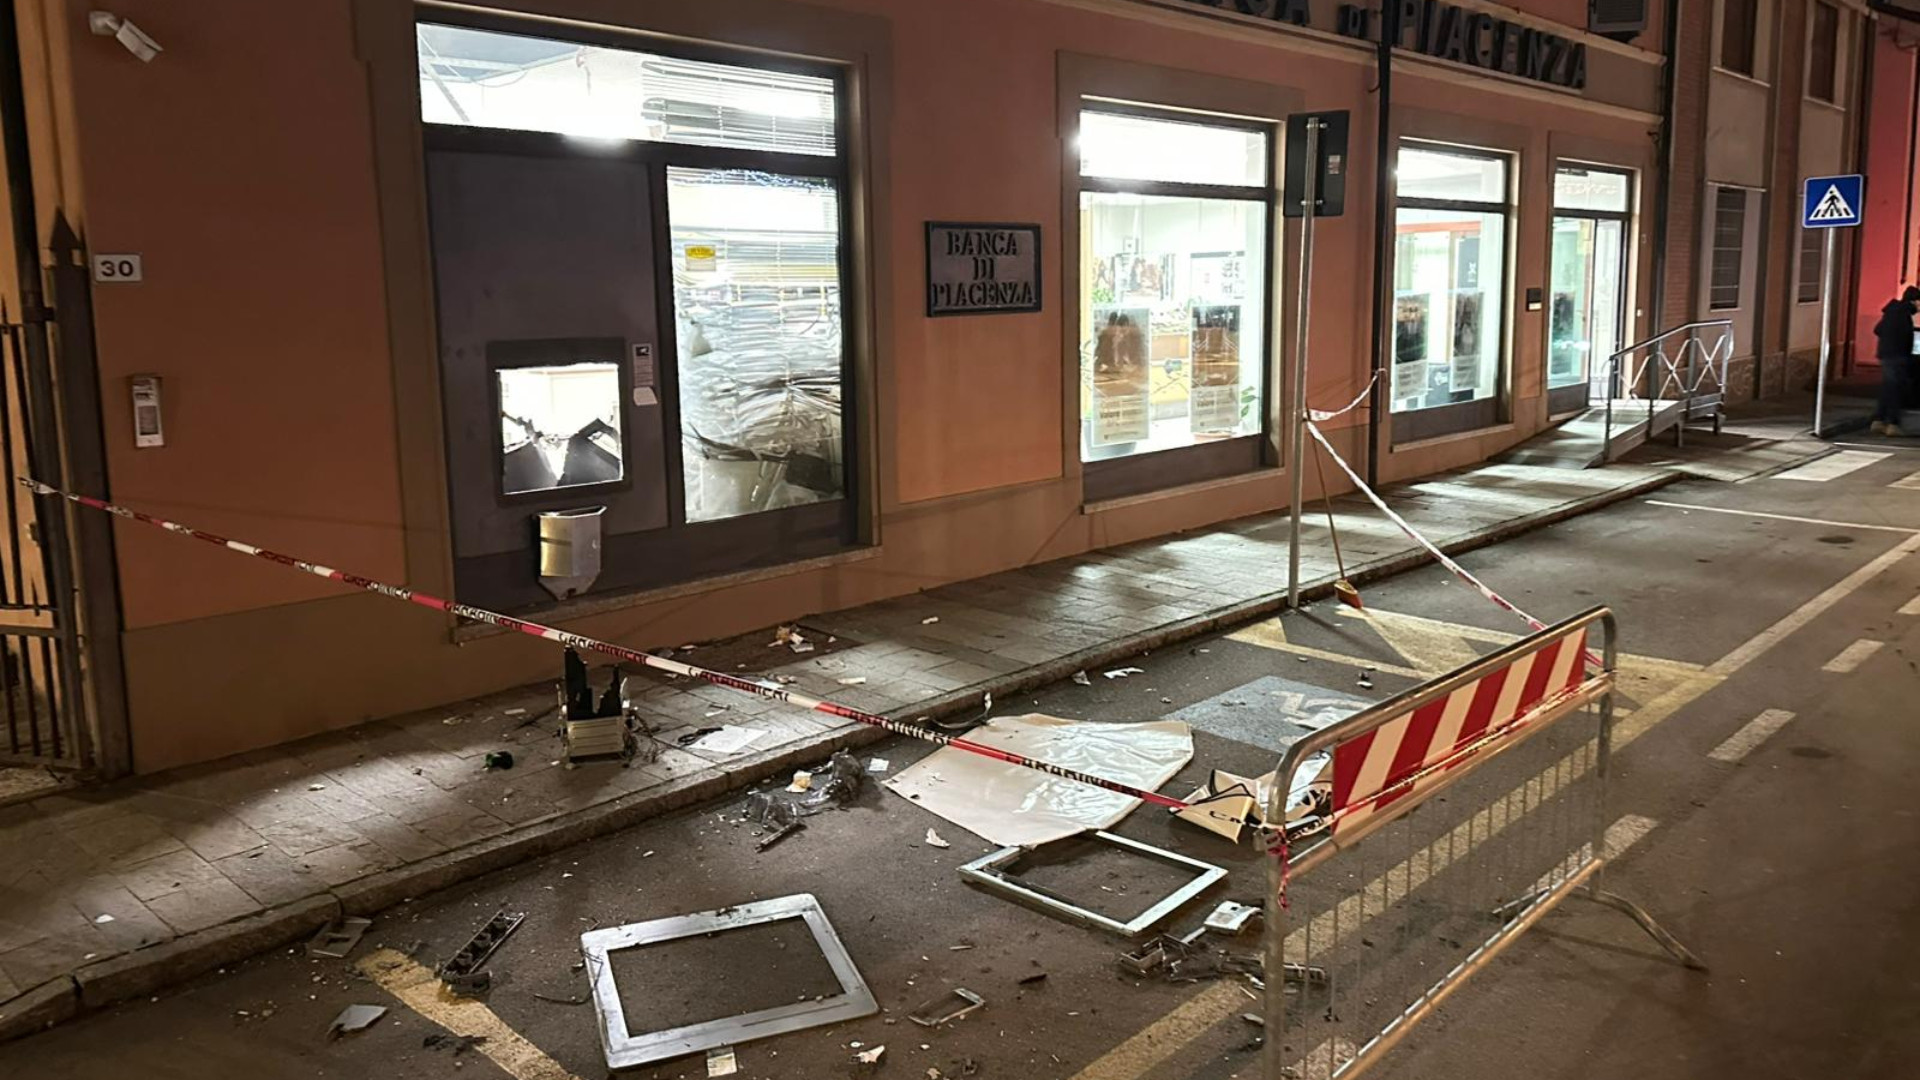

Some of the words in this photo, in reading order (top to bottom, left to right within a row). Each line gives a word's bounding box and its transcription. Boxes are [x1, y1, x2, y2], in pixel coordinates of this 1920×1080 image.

[1392, 0, 1586, 90] PIACENZA
[947, 231, 1017, 256] BANCA
[101, 260, 134, 277] 30
[972, 256, 995, 281] DI
[932, 281, 1034, 307] PIACENZA
